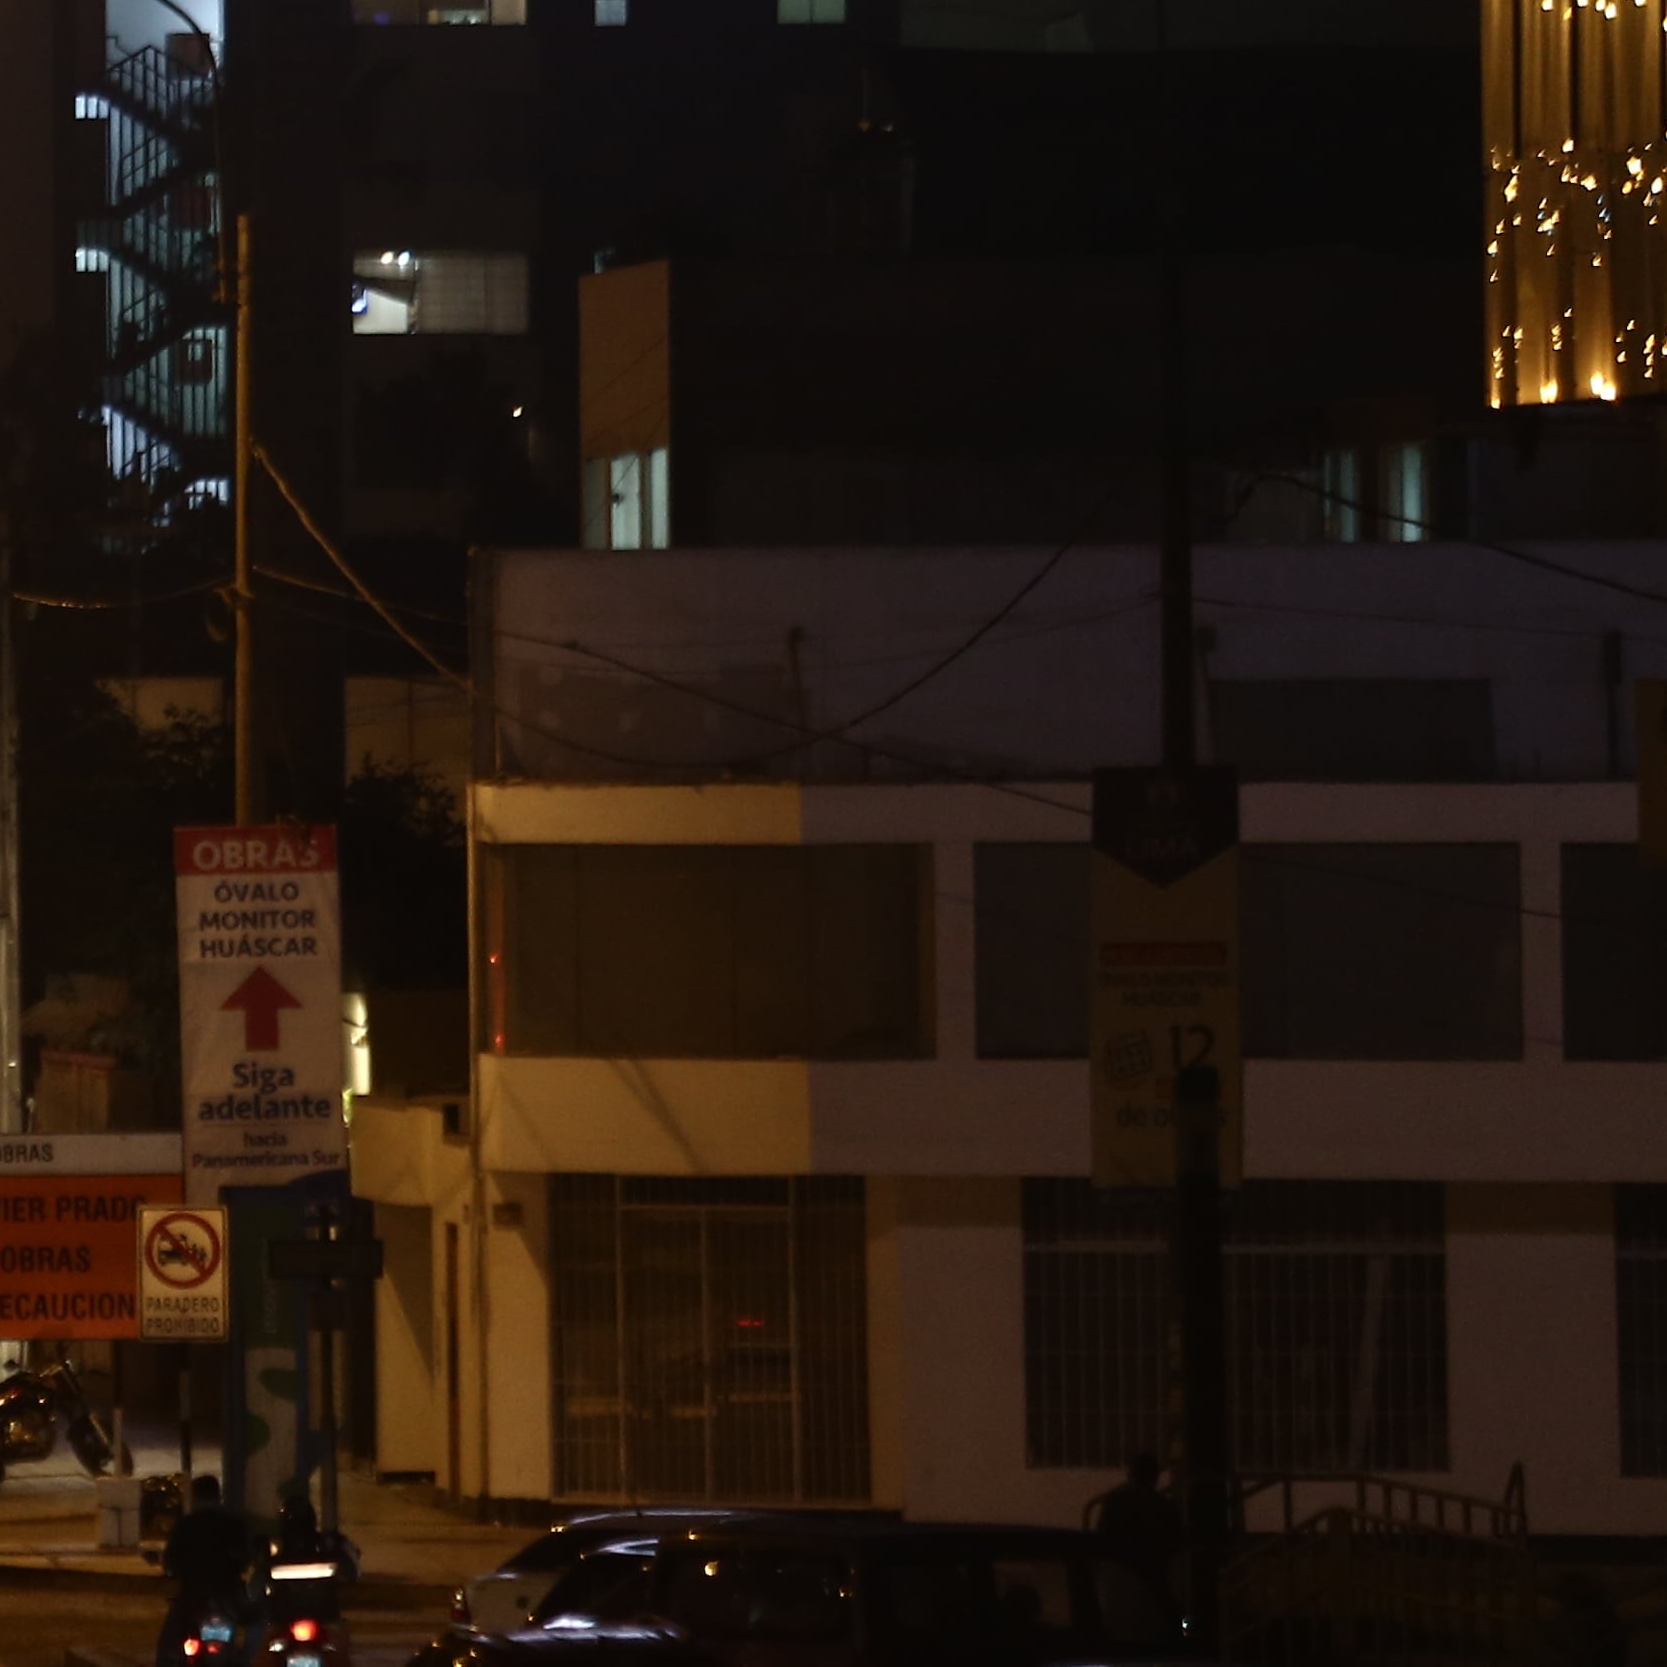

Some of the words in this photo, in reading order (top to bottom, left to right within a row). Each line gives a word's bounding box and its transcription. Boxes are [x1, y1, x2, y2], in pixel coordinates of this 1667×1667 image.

[192, 839, 320, 872] OBRAS
[214, 879, 300, 905] ÓVALO
[199, 907, 316, 932] MONITOR
[200, 933, 318, 959] HUÁSCAR
[232, 1062, 296, 1093] Siga
[198, 1093, 332, 1122] adelante
[192, 1152, 308, 1170] Panamericana
[312, 1151, 340, 1168] Sur
[0, 1246, 92, 1274] OBRAS
[146, 1296, 221, 1313] PARADERO
[146, 1317, 221, 1335] PROHIBIDO
